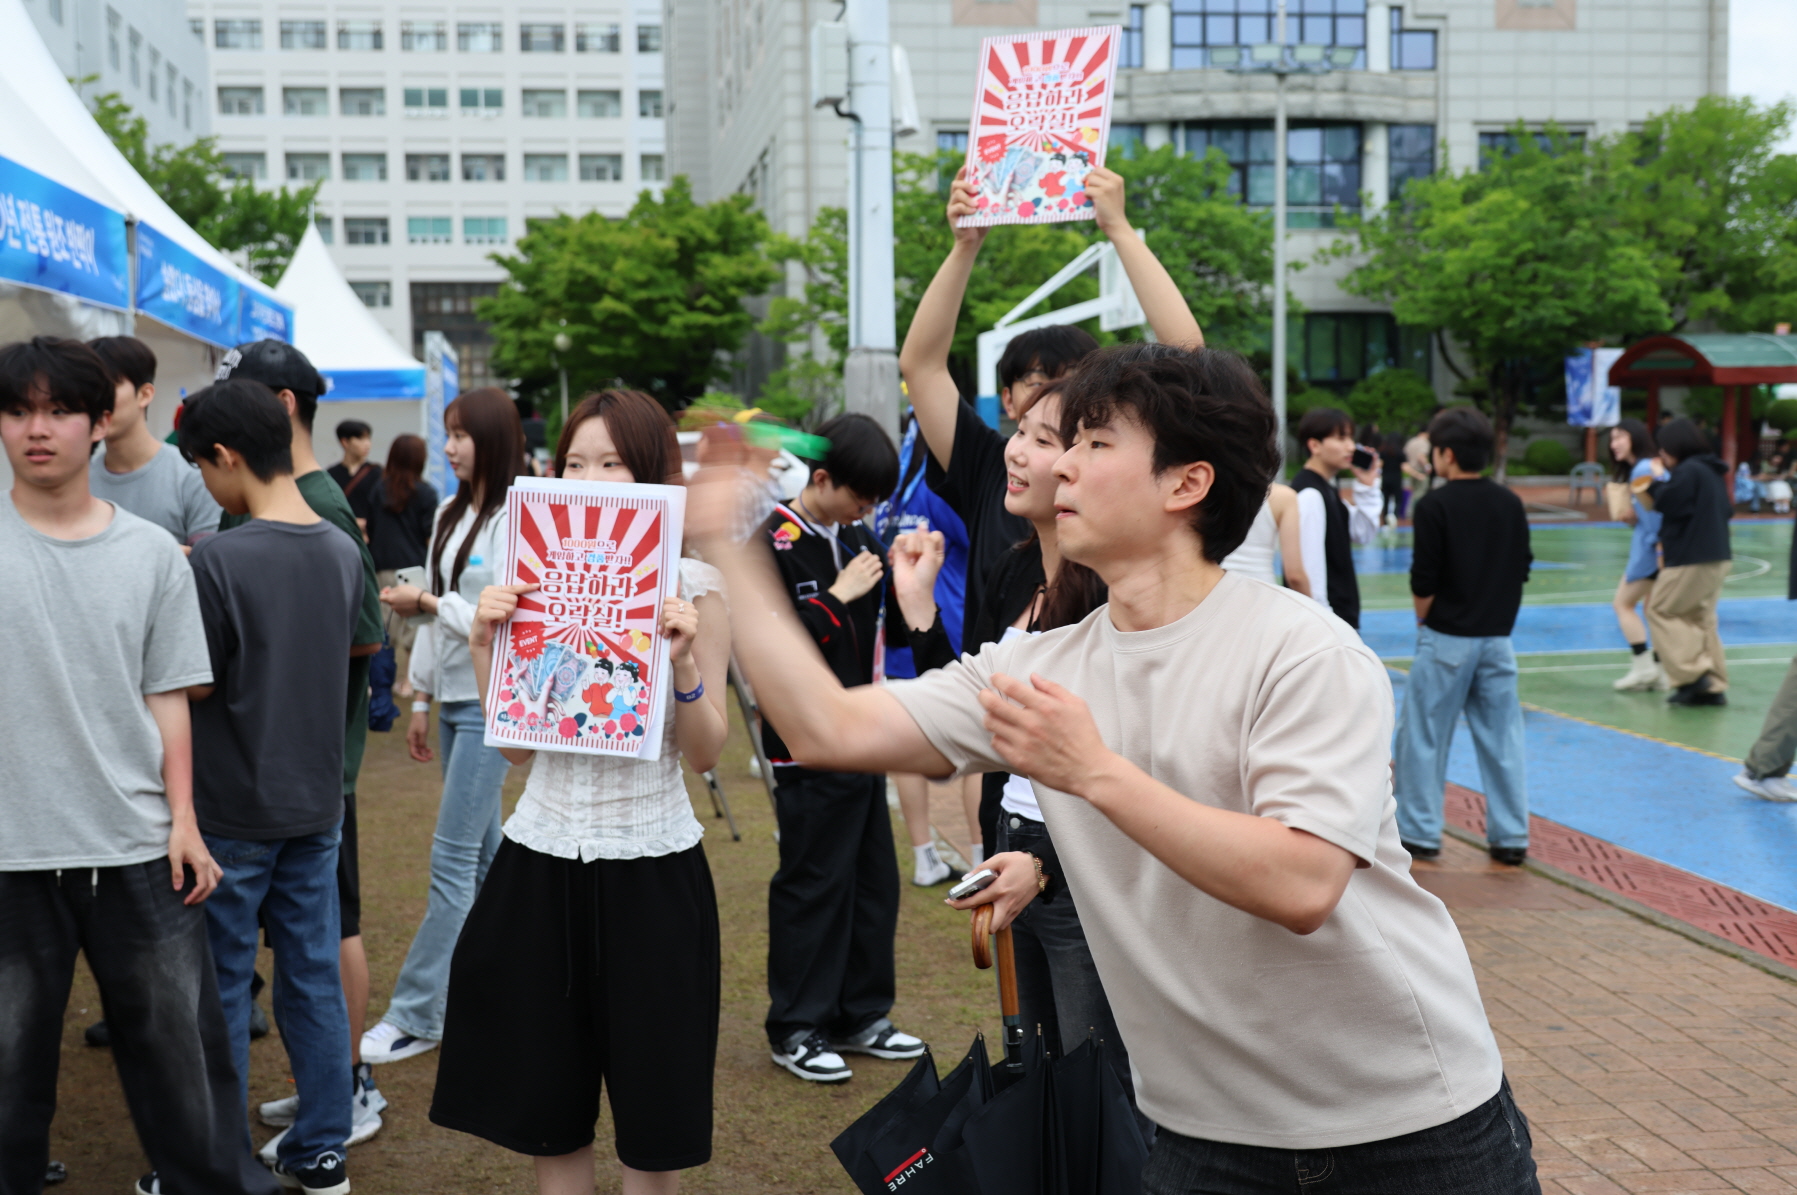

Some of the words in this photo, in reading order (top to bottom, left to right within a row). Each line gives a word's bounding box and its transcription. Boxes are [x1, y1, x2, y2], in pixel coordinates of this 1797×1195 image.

[1006, 88, 1085, 110] 응답하라
[1008, 112, 1074, 132] 오락실!
[542, 571, 635, 599] 응답하라
[545, 602, 623, 629] 오락실!
[518, 634, 539, 648] EVENT
[888, 1153, 934, 1192] FAHRE
